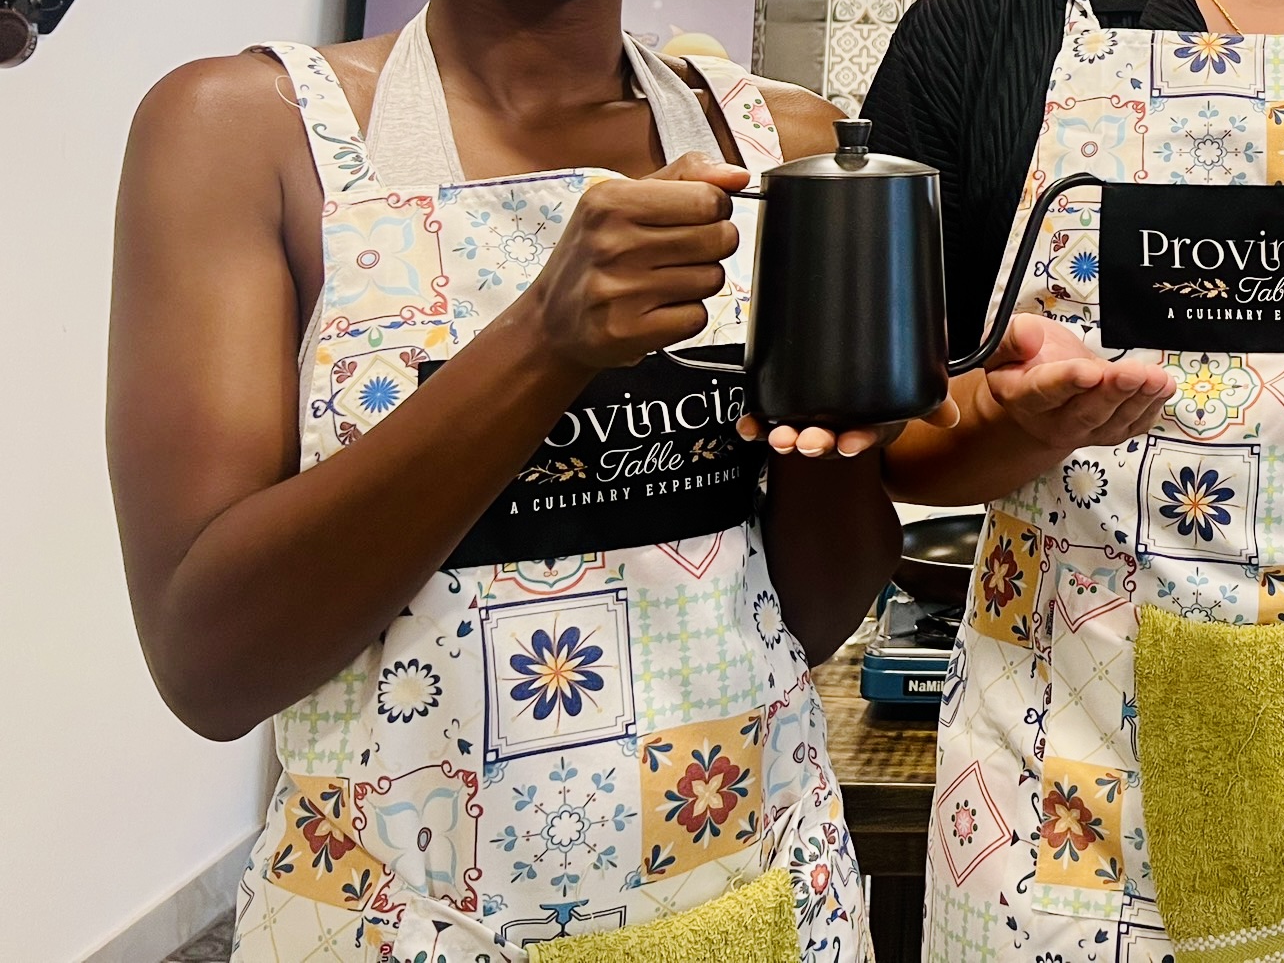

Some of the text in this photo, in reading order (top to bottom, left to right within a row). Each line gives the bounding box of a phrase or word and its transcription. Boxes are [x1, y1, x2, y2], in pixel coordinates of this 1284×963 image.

[1167, 308, 1175, 319] A
[1186, 308, 1263, 321] CULINARY
[543, 378, 746, 448] ovincia
[596, 440, 685, 482] Table
[510, 501, 519, 515] A
[533, 486, 631, 512] CULINARY
[908, 679, 945, 692] NaMil
